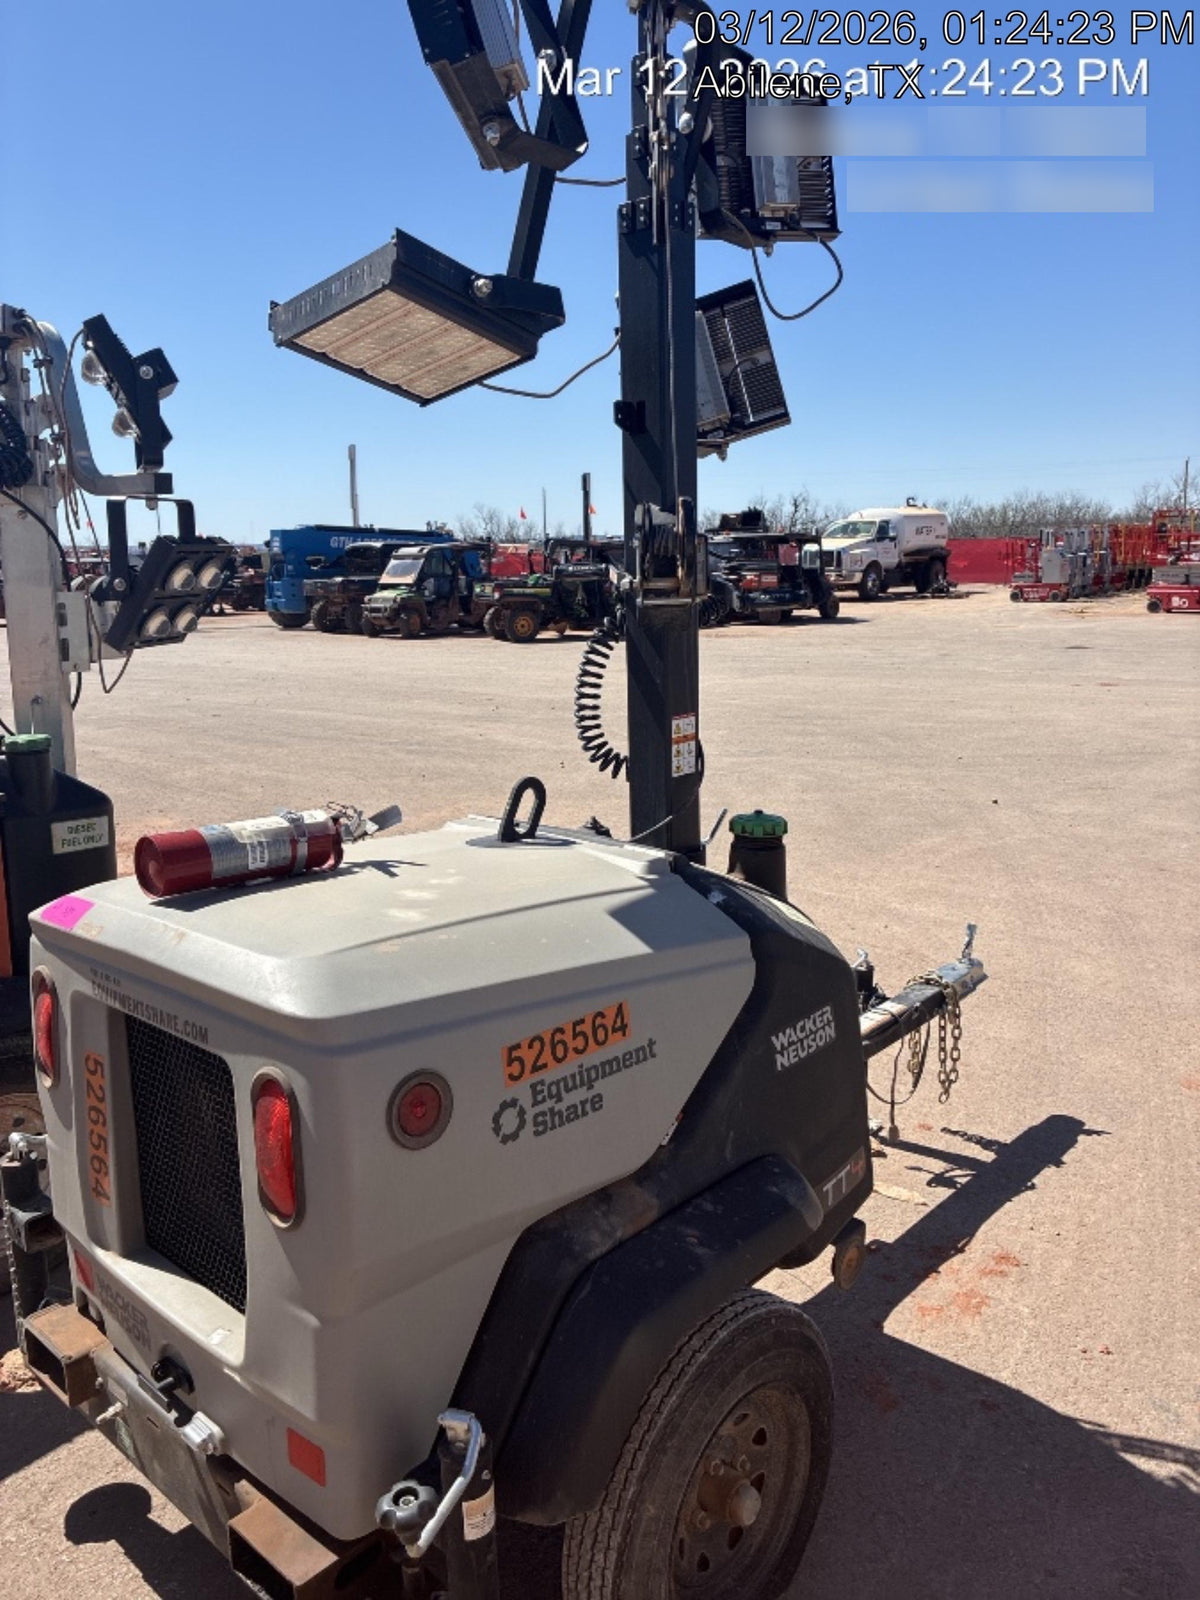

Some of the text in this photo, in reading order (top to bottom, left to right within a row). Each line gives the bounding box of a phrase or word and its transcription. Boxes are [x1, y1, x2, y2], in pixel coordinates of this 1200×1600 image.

[506, 1002, 629, 1082] 526564
[771, 1006, 833, 1051] WACKER
[775, 1022, 836, 1071] NEUSON
[529, 1037, 658, 1108] Equipment
[84, 1053, 110, 1202] 526564
[532, 1092, 604, 1137] Share
